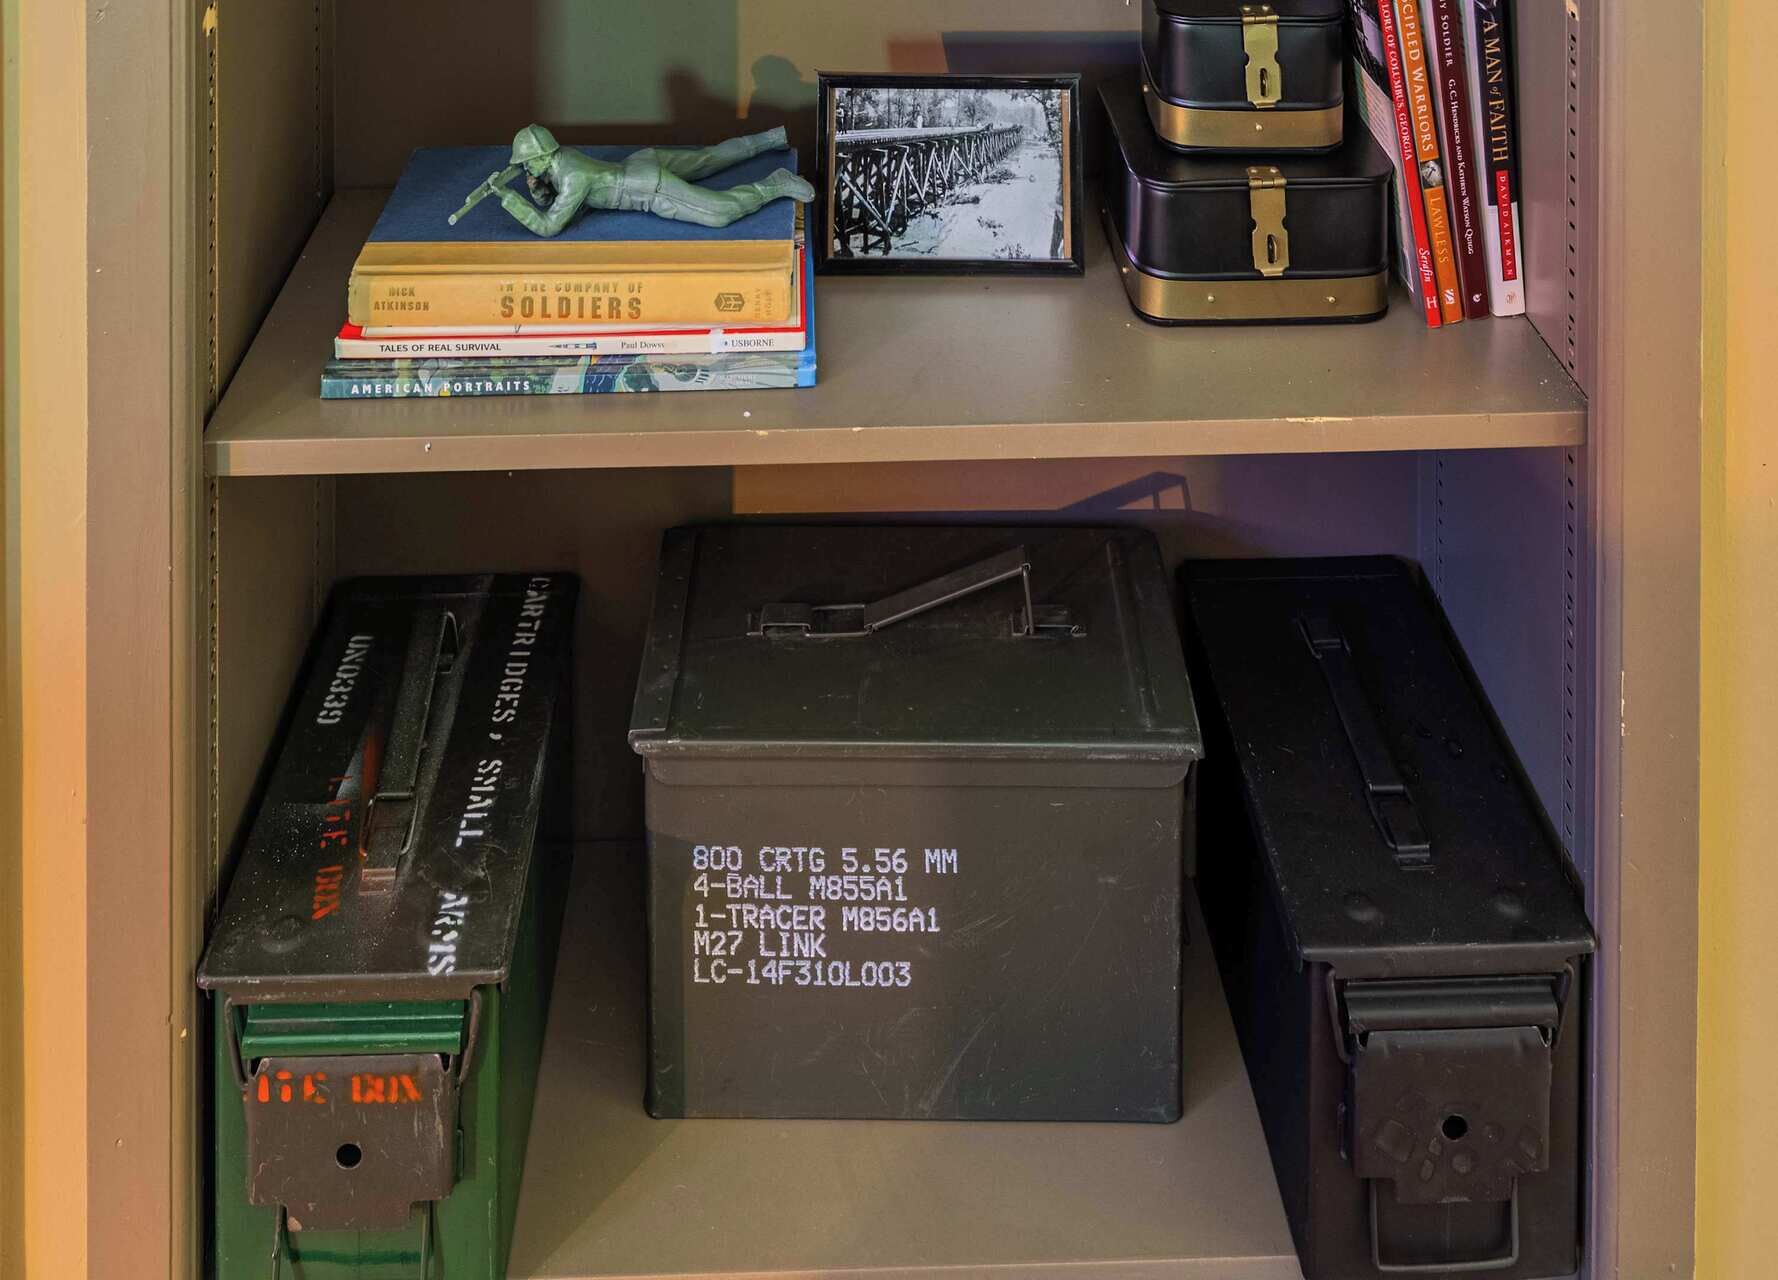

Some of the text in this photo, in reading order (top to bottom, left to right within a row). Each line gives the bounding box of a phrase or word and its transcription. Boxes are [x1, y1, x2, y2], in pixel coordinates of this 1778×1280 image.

[1381, 3, 1392, 33] LORE
[1385, 34, 1395, 49] OF
[1441, 15, 1453, 67] SOLDIER
[1482, 18, 1508, 161] A MAN of FAITH
[1411, 67, 1433, 152] WARRIORS
[1399, 112, 1412, 160] GEORGIA
[1430, 197, 1449, 263] LAWLESS
[1499, 176, 1513, 275] DAVID AIKMAN
[1463, 229, 1475, 254] QUIGG
[1418, 247, 1432, 283] Serafin
[555, 282, 618, 293] COMPANY
[628, 283, 643, 293] OF
[374, 301, 430, 311] ATKINSON
[501, 296, 641, 319] SOLDIERS
[379, 342, 502, 353] TALES OF REAL SURVIVAL
[621, 341, 638, 349] Paul
[731, 338, 774, 348] USBORNE
[351, 380, 530, 395] AMERICAN PORTRAITS
[456, 758, 503, 847] SMALL
[693, 845, 959, 874] 800 CRTG 5.56 MM
[693, 873, 908, 901] 4-BALL M855A1
[695, 904, 940, 932] 1-TRACER M856A1
[694, 931, 827, 957] M27 LINK
